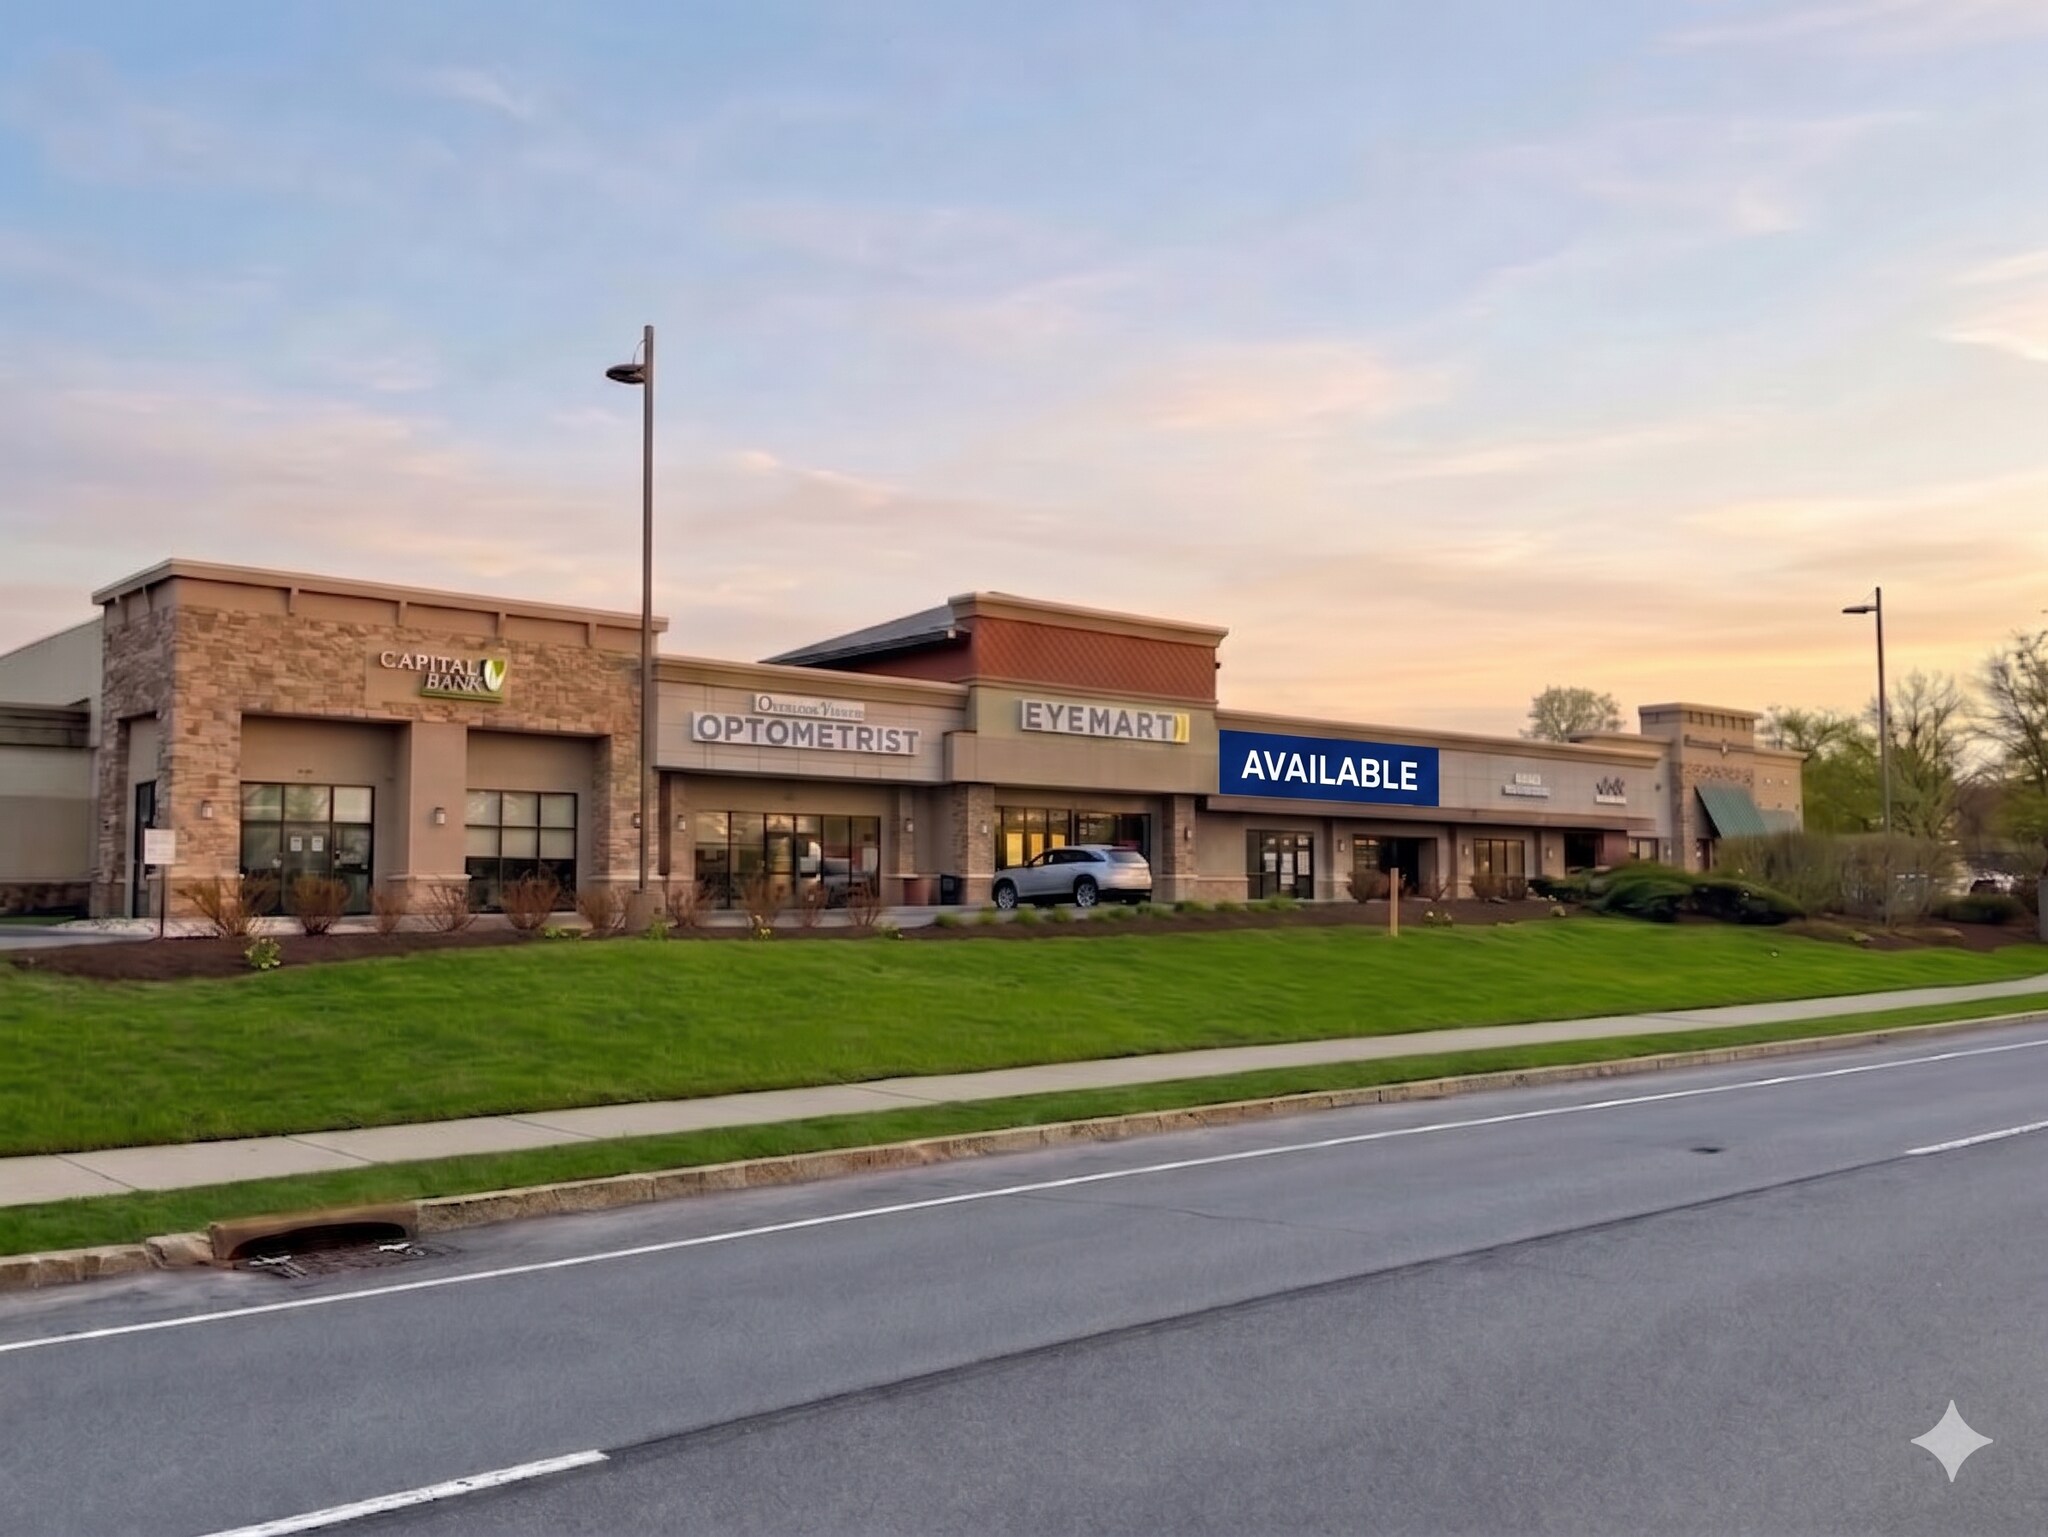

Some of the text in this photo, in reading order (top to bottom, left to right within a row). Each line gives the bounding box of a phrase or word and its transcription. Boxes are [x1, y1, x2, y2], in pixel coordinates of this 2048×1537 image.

[380, 651, 479, 676] CAPITAL
[426, 673, 482, 693] BANK
[697, 714, 919, 753] OPTOMETRIST
[1026, 702, 1173, 739] EYEMART
[1241, 749, 1418, 791] AVAILABLE
